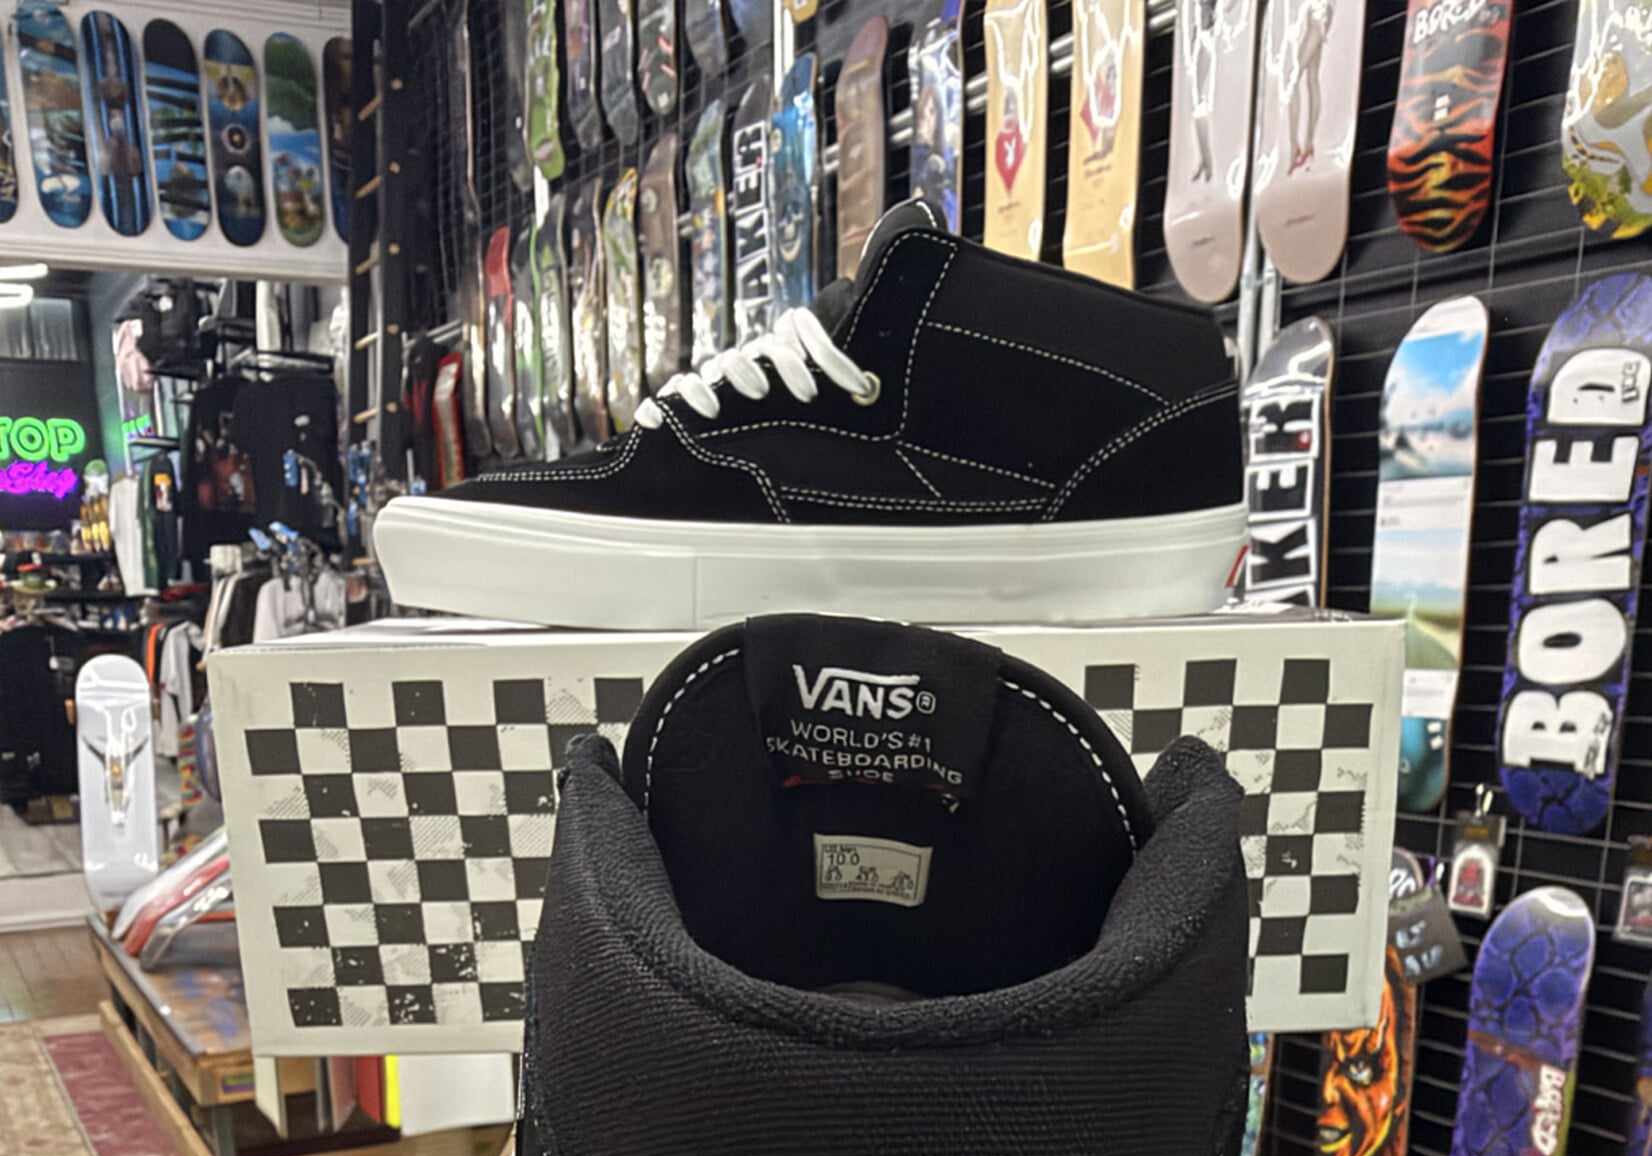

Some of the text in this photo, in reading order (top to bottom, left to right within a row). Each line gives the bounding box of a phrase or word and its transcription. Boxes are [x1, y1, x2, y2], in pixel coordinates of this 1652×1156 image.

[1503, 348, 1651, 775] BORED
[790, 719, 932, 752] WORLD'S #1
[766, 737, 962, 785] SKATEBOARDING
